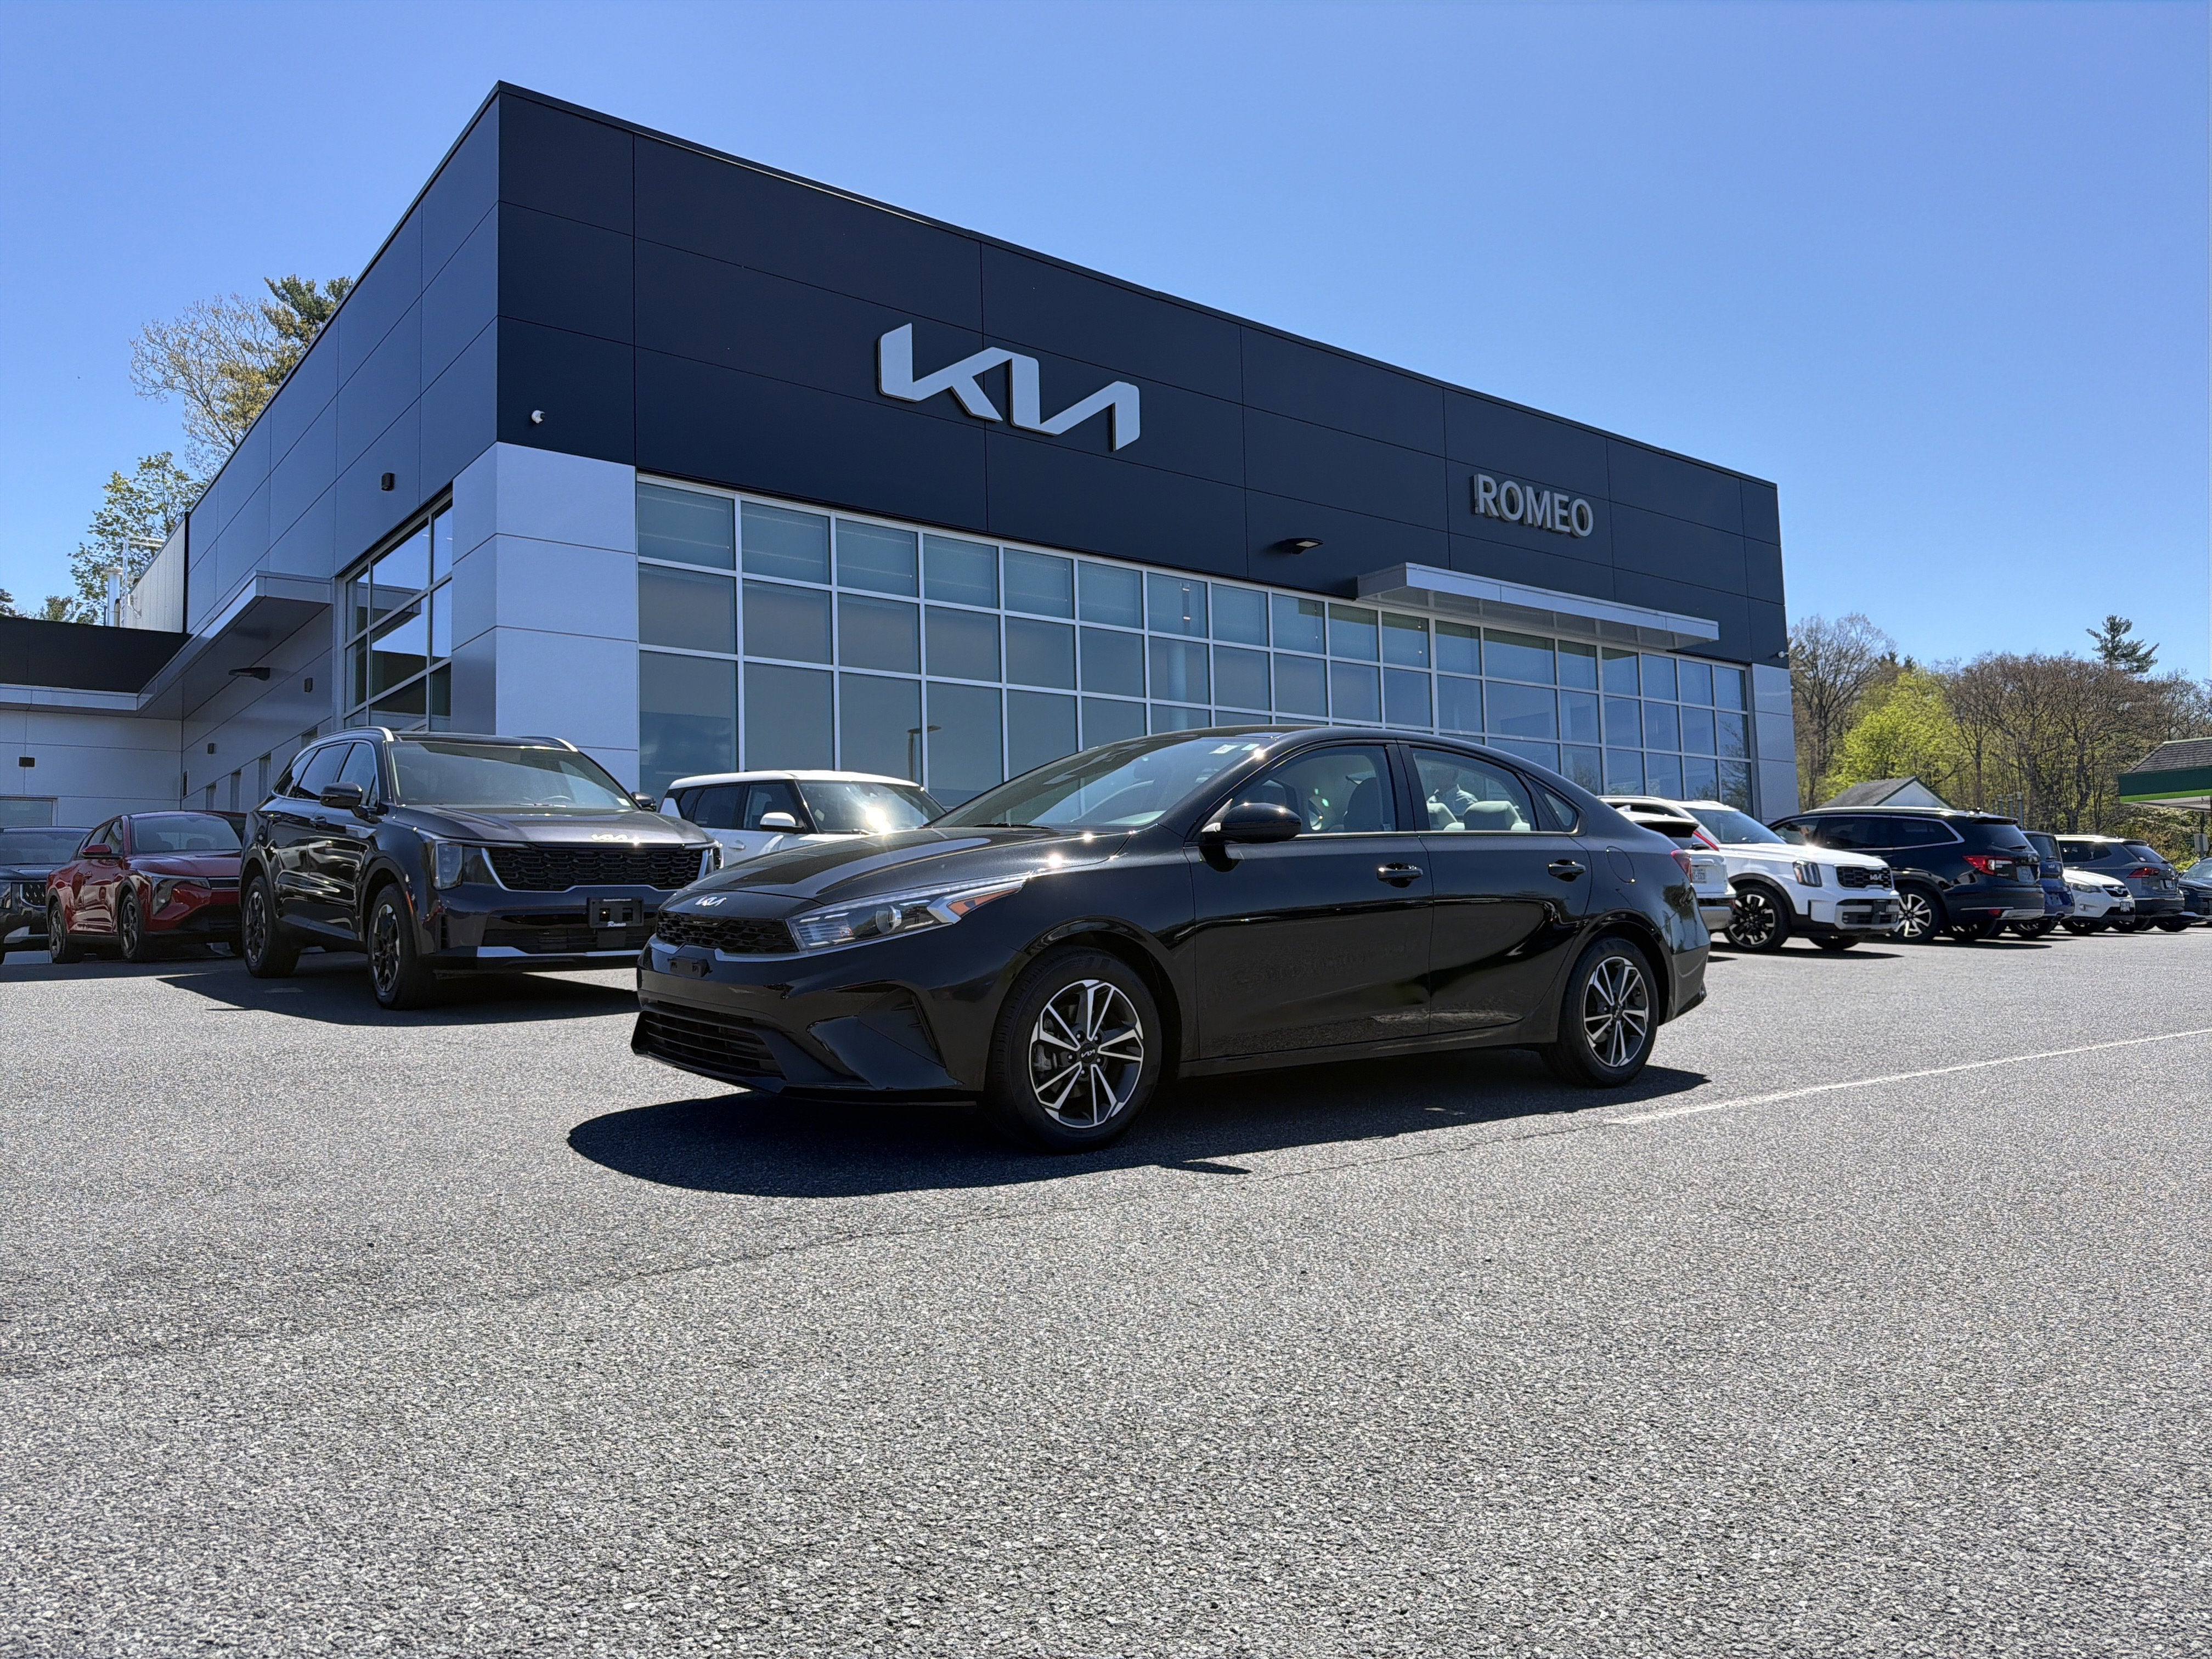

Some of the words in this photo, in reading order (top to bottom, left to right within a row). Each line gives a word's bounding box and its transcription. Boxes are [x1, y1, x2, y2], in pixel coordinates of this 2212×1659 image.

[879, 323, 1140, 451] KIA
[1474, 473, 1593, 537] ROMEO
[695, 896, 726, 907] KIA
